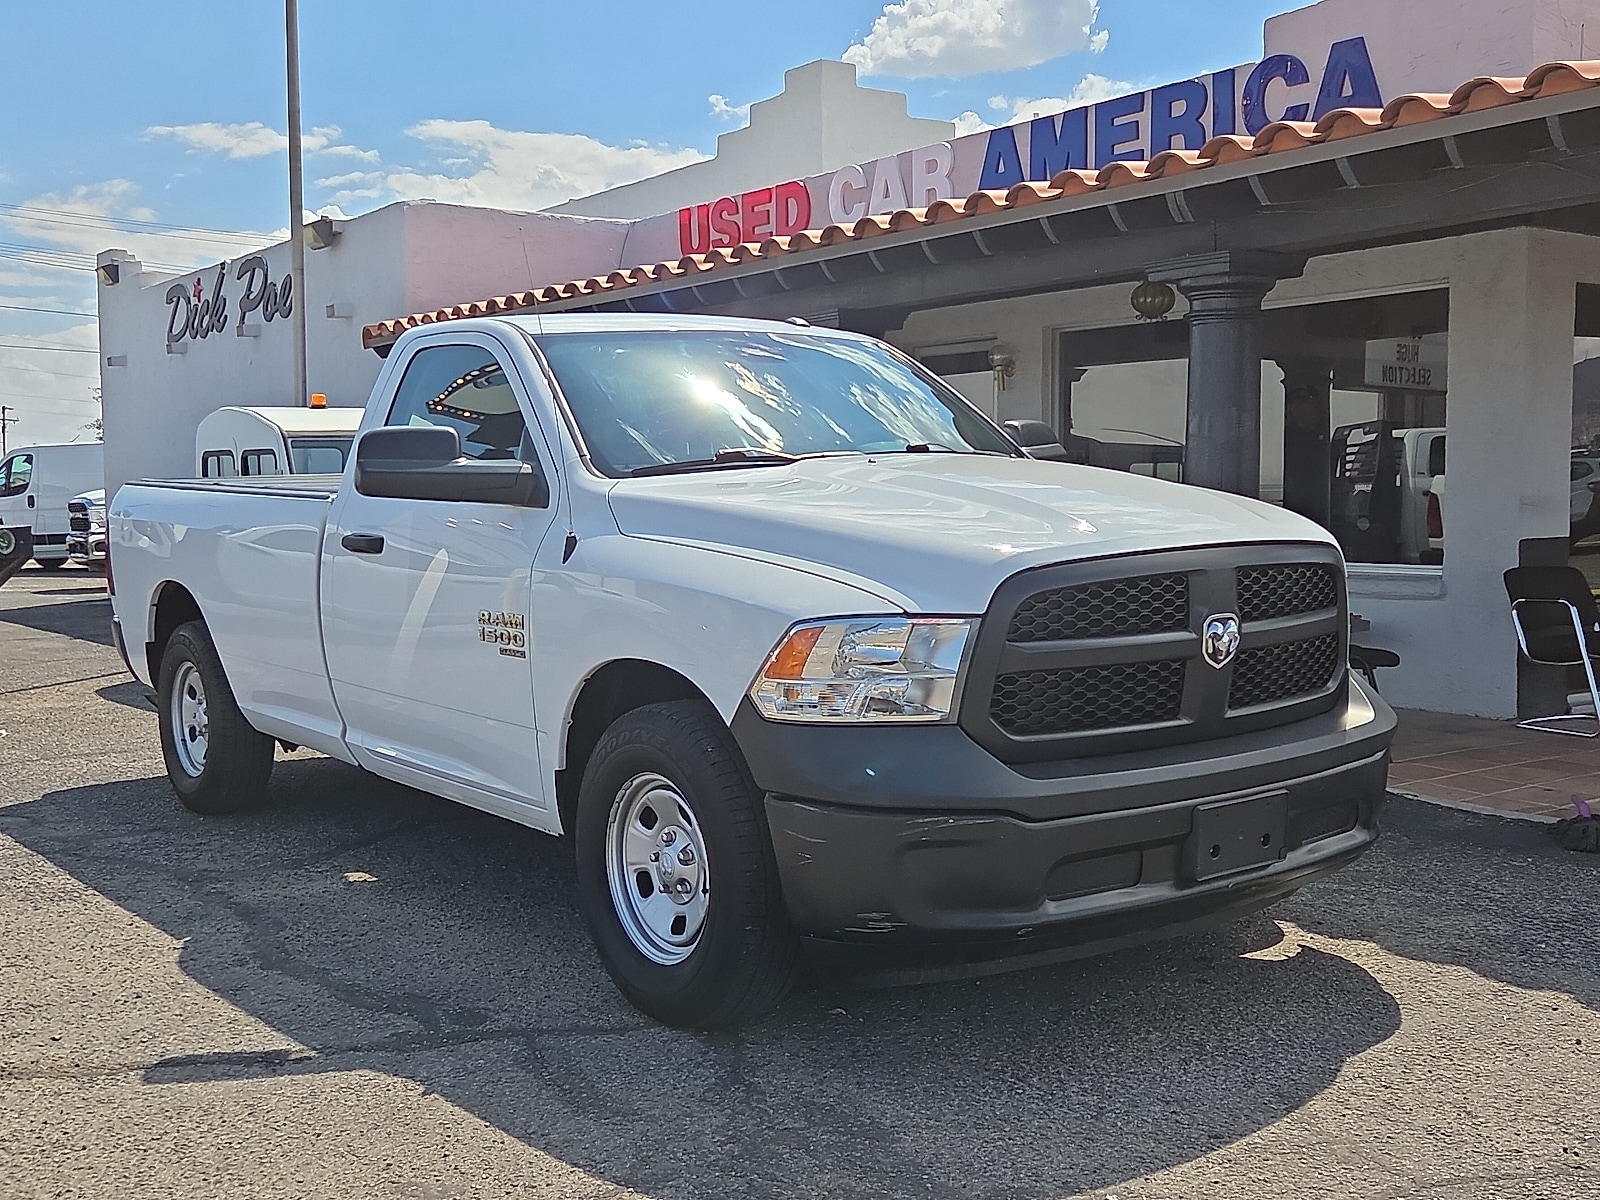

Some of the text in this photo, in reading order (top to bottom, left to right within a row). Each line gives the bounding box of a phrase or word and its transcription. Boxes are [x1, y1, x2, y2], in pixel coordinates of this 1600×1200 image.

[679, 36, 1384, 256] USED CAR AMERICA
[165, 254, 293, 343] Dick Poe
[478, 608, 525, 630] RAM
[478, 626, 526, 648] 1500
